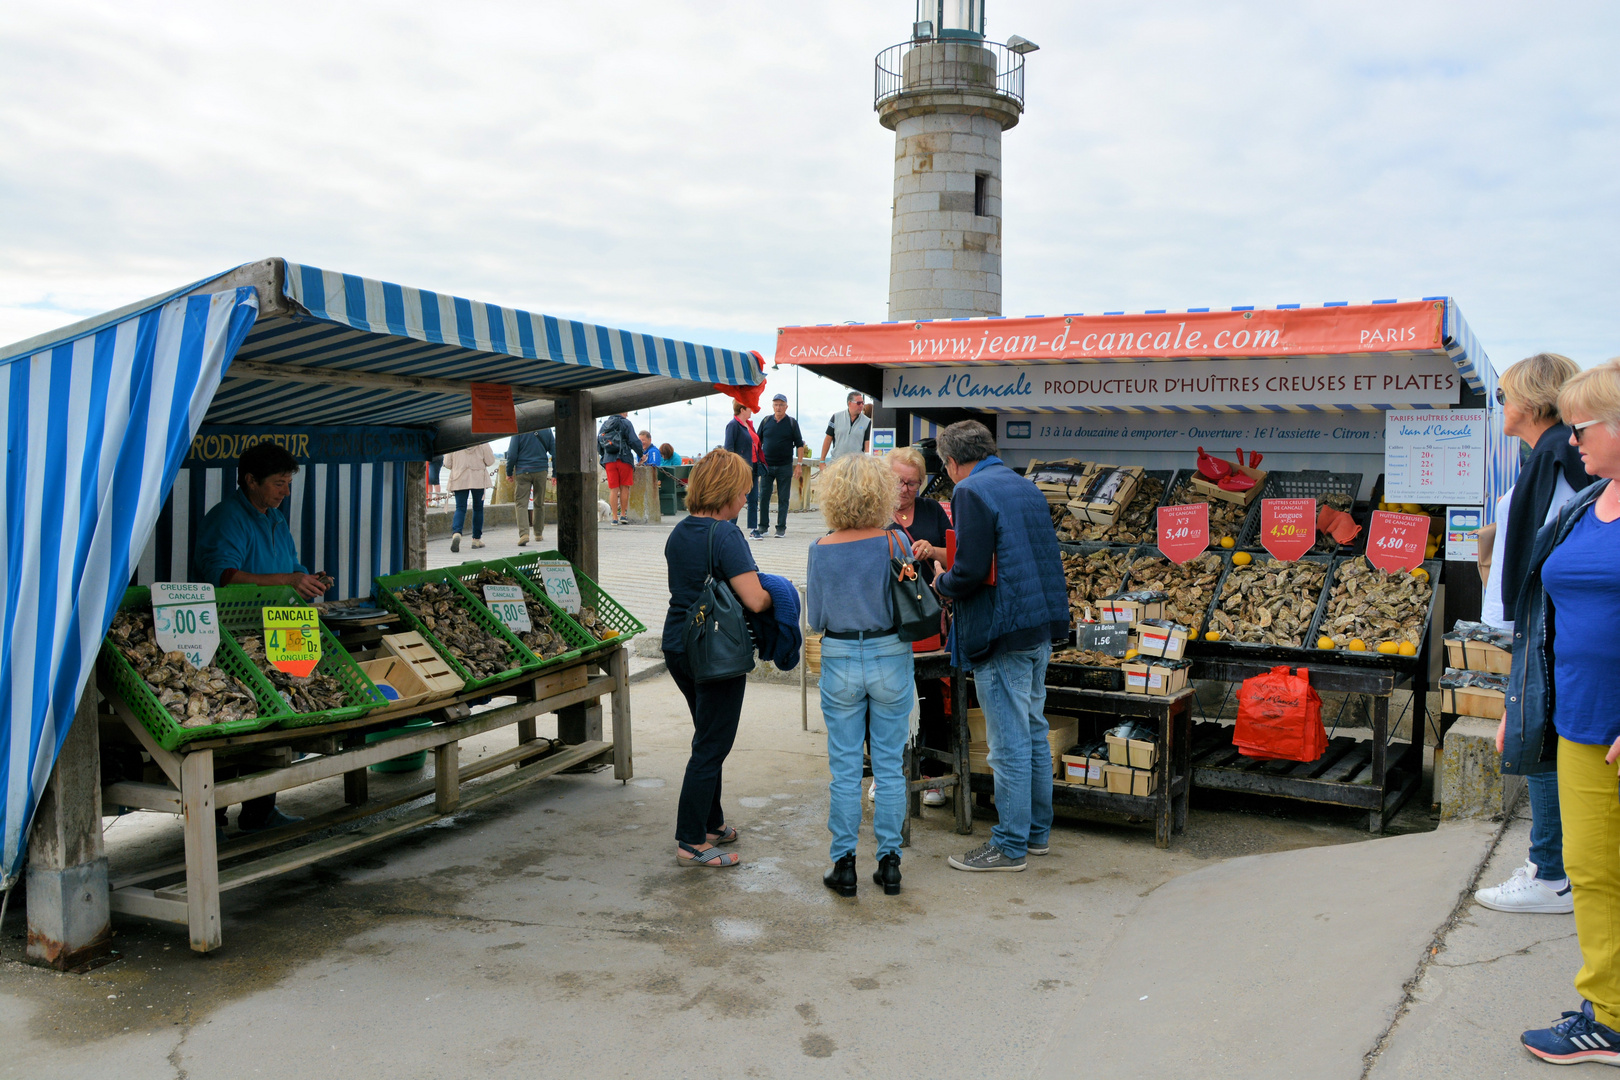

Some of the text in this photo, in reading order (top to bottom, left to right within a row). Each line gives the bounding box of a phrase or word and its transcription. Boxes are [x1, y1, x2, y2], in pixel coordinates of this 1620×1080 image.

[788, 322, 1416, 360] CANCALE www.jean-d-cancale.com PARIS
[892, 371, 1454, 398] Jean d'Cancale PRODUCTEUR D'HUÎTRES CREUSES ET PLATES
[1040, 427, 1050, 437] 13
[1054, 426, 1060, 437] à
[1062, 426, 1072, 437] la
[1074, 426, 1118, 438] douzaine
[1122, 426, 1128, 438] à
[1130, 428, 1178, 440] emporter
[1188, 427, 1242, 438] Ouverture
[1254, 427, 1267, 438] 1€
[1332, 427, 1370, 439] Citron
[1400, 425, 1421, 436] Jean
[1423, 424, 1471, 436] d'Cancale
[188, 434, 310, 462] RODUCTEUR
[1452, 515, 1478, 526] CB
[1165, 527, 1189, 540] 5,40
[1270, 525, 1295, 537] 4,50
[1376, 536, 1403, 549] 4,80
[268, 610, 314, 621] CANCALE
[156, 607, 196, 639] 5,00
[307, 640, 318, 652] Dz
[1094, 636, 1110, 645] 1.5€
[186, 652, 202, 666] °4
